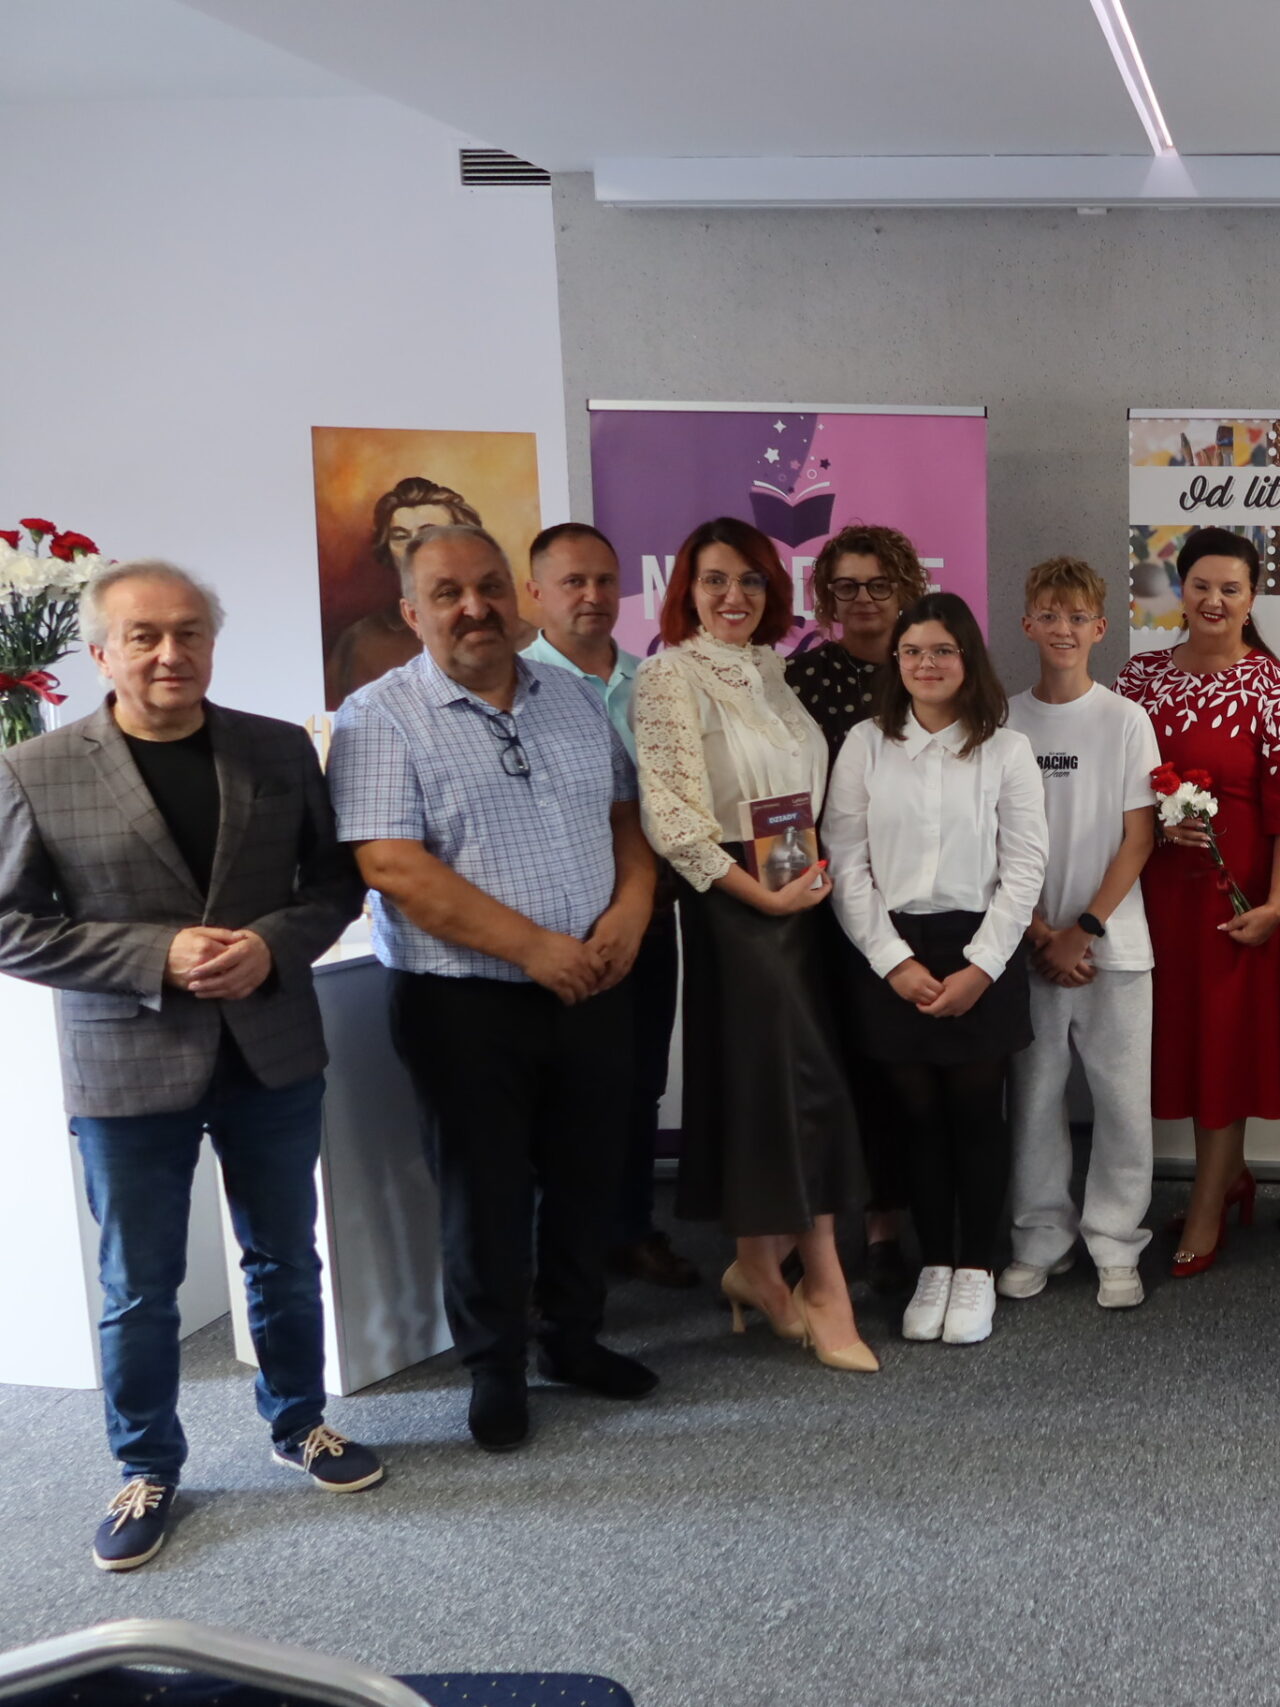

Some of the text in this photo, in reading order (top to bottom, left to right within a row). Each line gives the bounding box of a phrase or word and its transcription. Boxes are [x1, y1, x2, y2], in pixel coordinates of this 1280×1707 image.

[1179, 474, 1234, 511] Od
[1036, 755, 1079, 770] RACING
[768, 812, 799, 825] DZIADY
